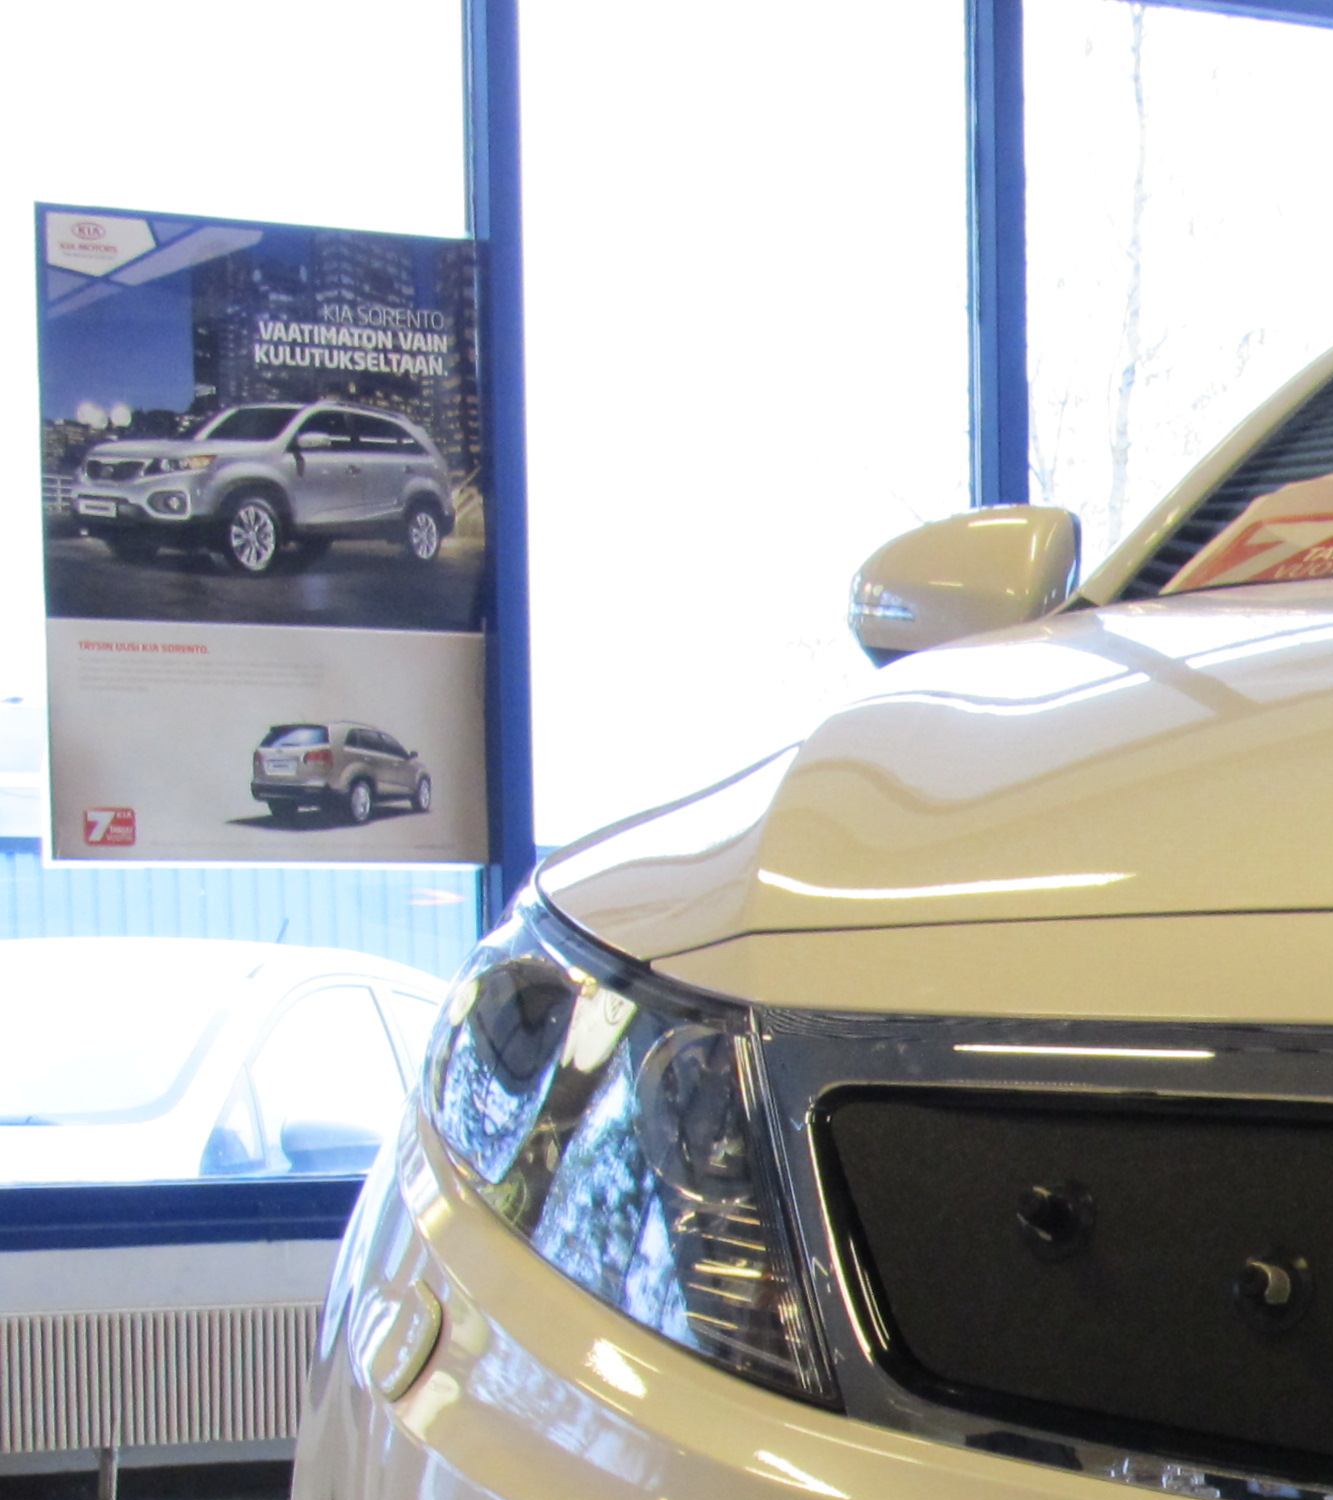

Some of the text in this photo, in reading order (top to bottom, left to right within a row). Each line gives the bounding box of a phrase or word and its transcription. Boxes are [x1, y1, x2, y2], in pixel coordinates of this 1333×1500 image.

[322, 304, 354, 324] KIA
[258, 320, 449, 353] VAATIMATON VAIN
[254, 343, 449, 377] KULUTUKSELTAAN.
[87, 811, 116, 842] 7
